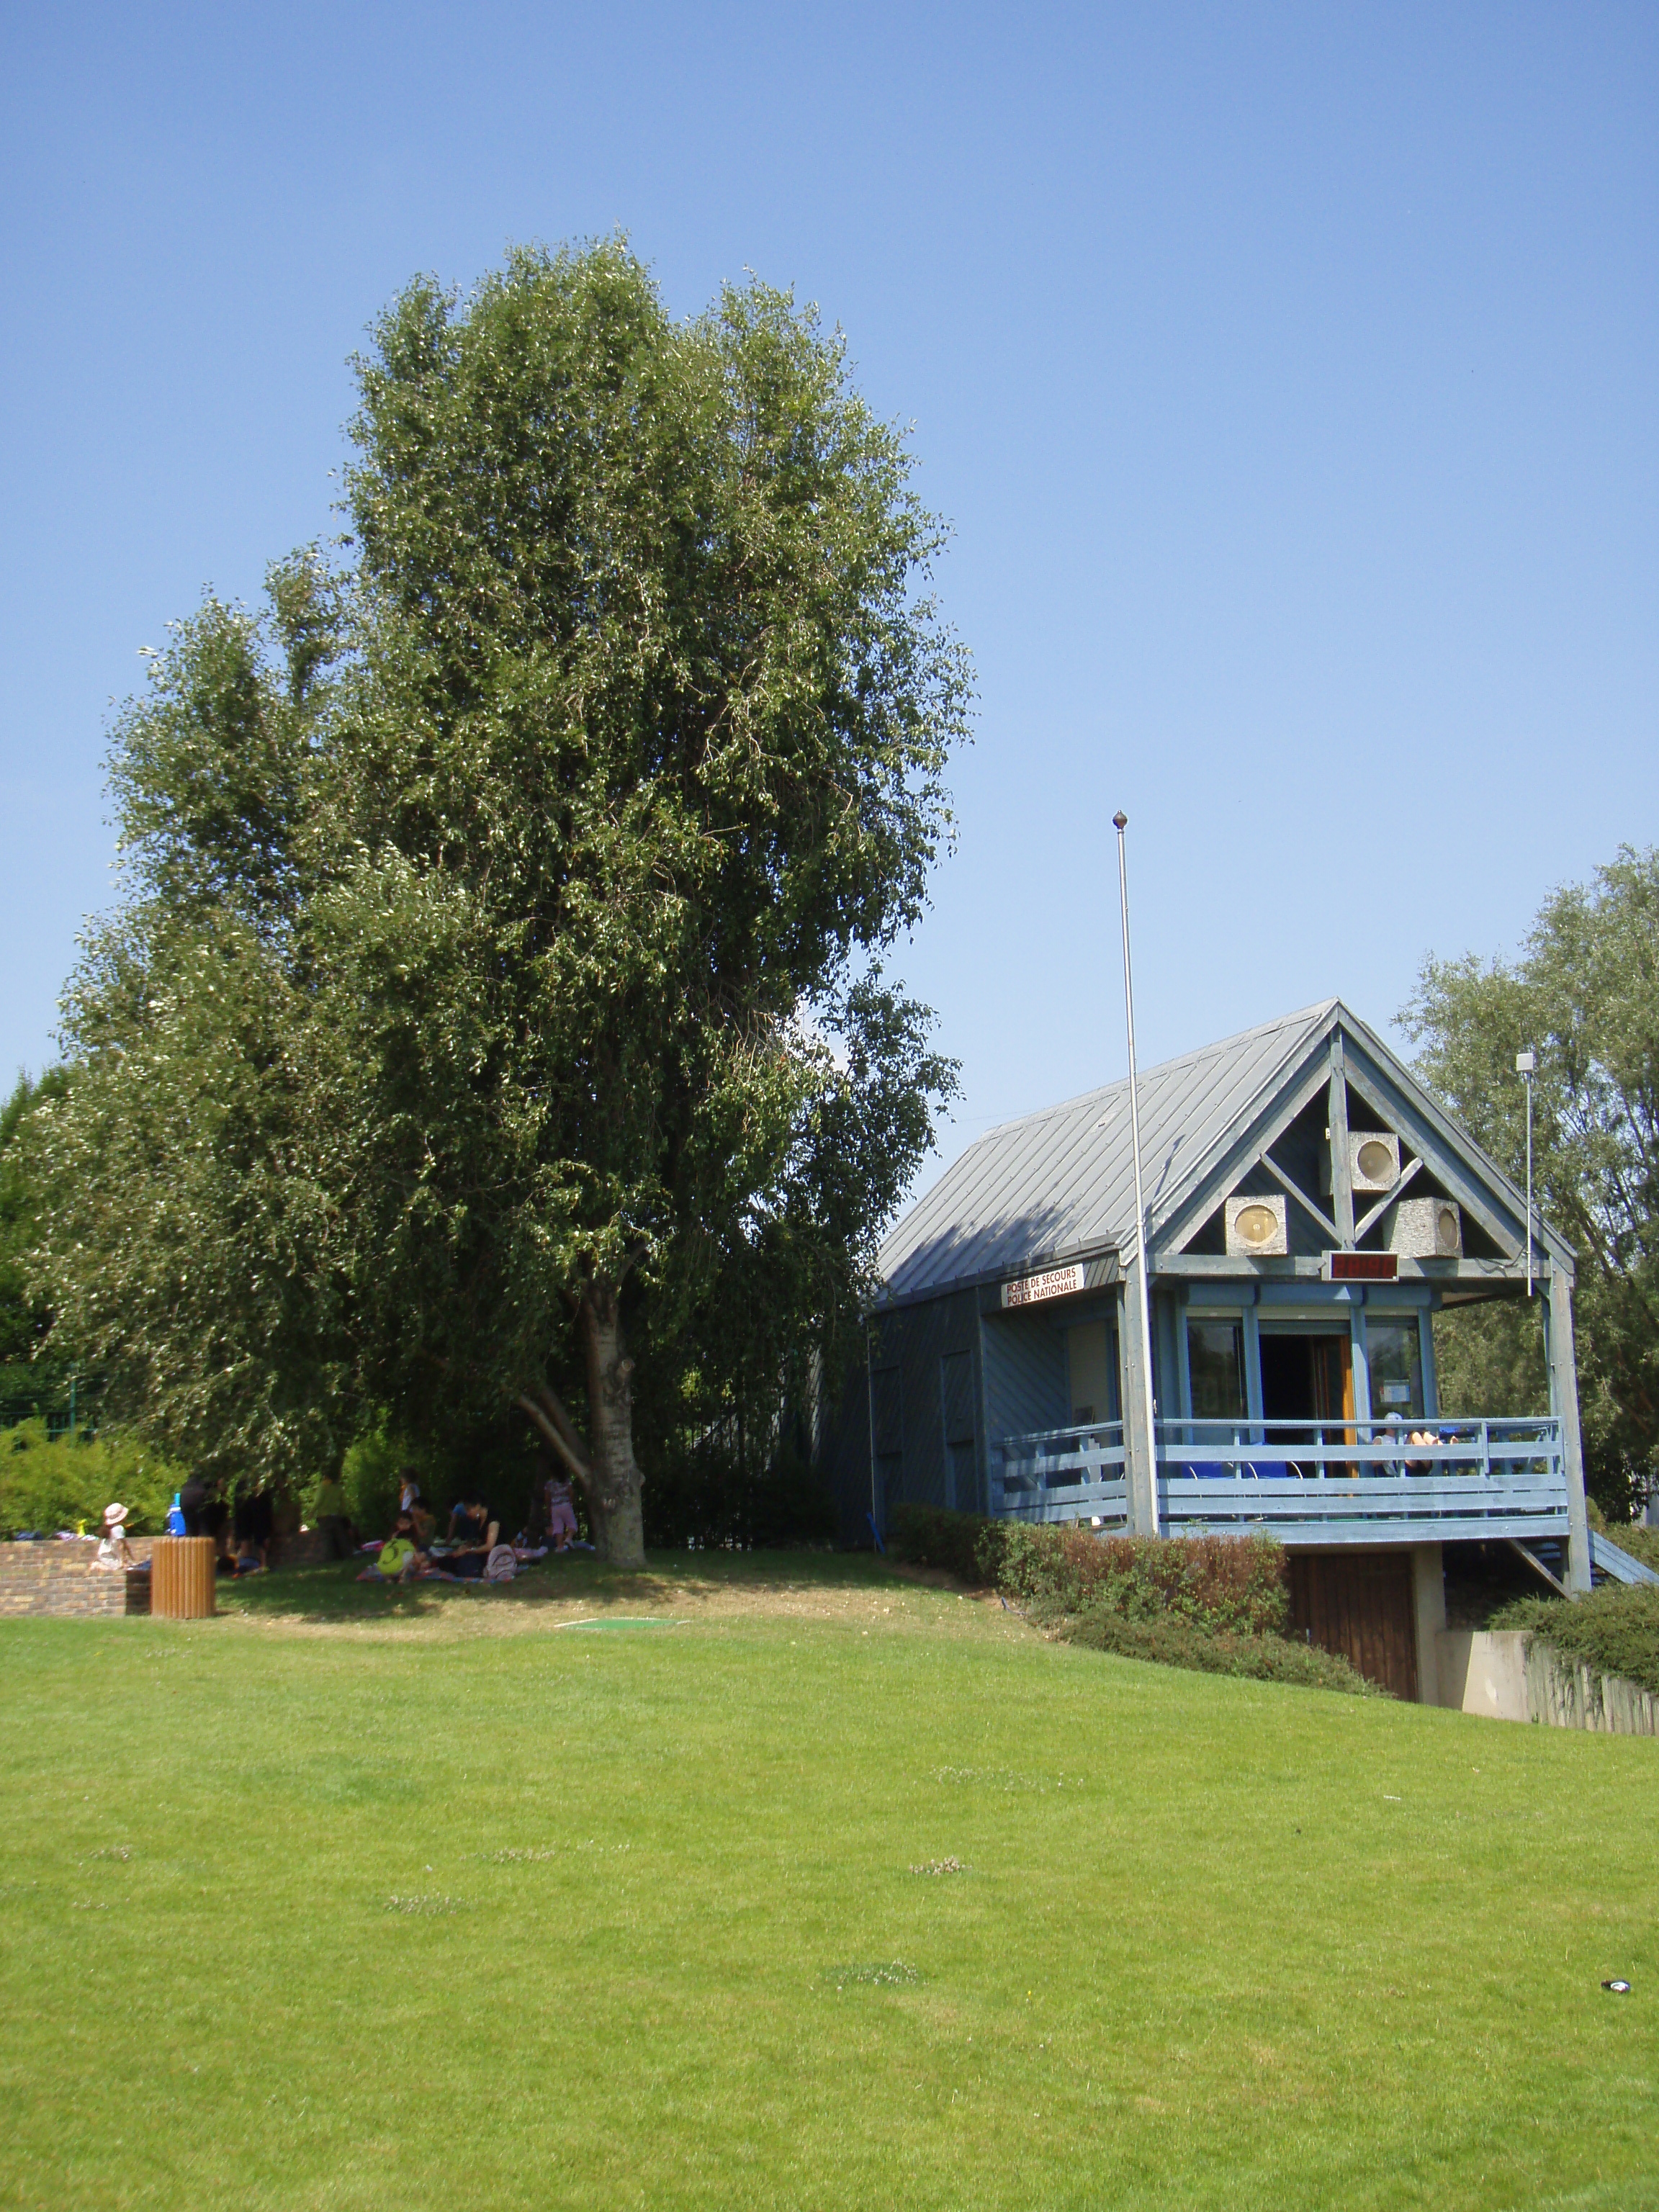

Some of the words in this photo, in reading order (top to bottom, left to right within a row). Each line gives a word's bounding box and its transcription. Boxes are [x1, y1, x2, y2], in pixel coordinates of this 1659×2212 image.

[1007, 1279, 1029, 1294] POSTE
[1030, 1277, 1040, 1288] DE
[1042, 1267, 1076, 1285] SECOURS
[1007, 1291, 1031, 1305] POLICE
[1034, 1280, 1076, 1299] NATIONALE
